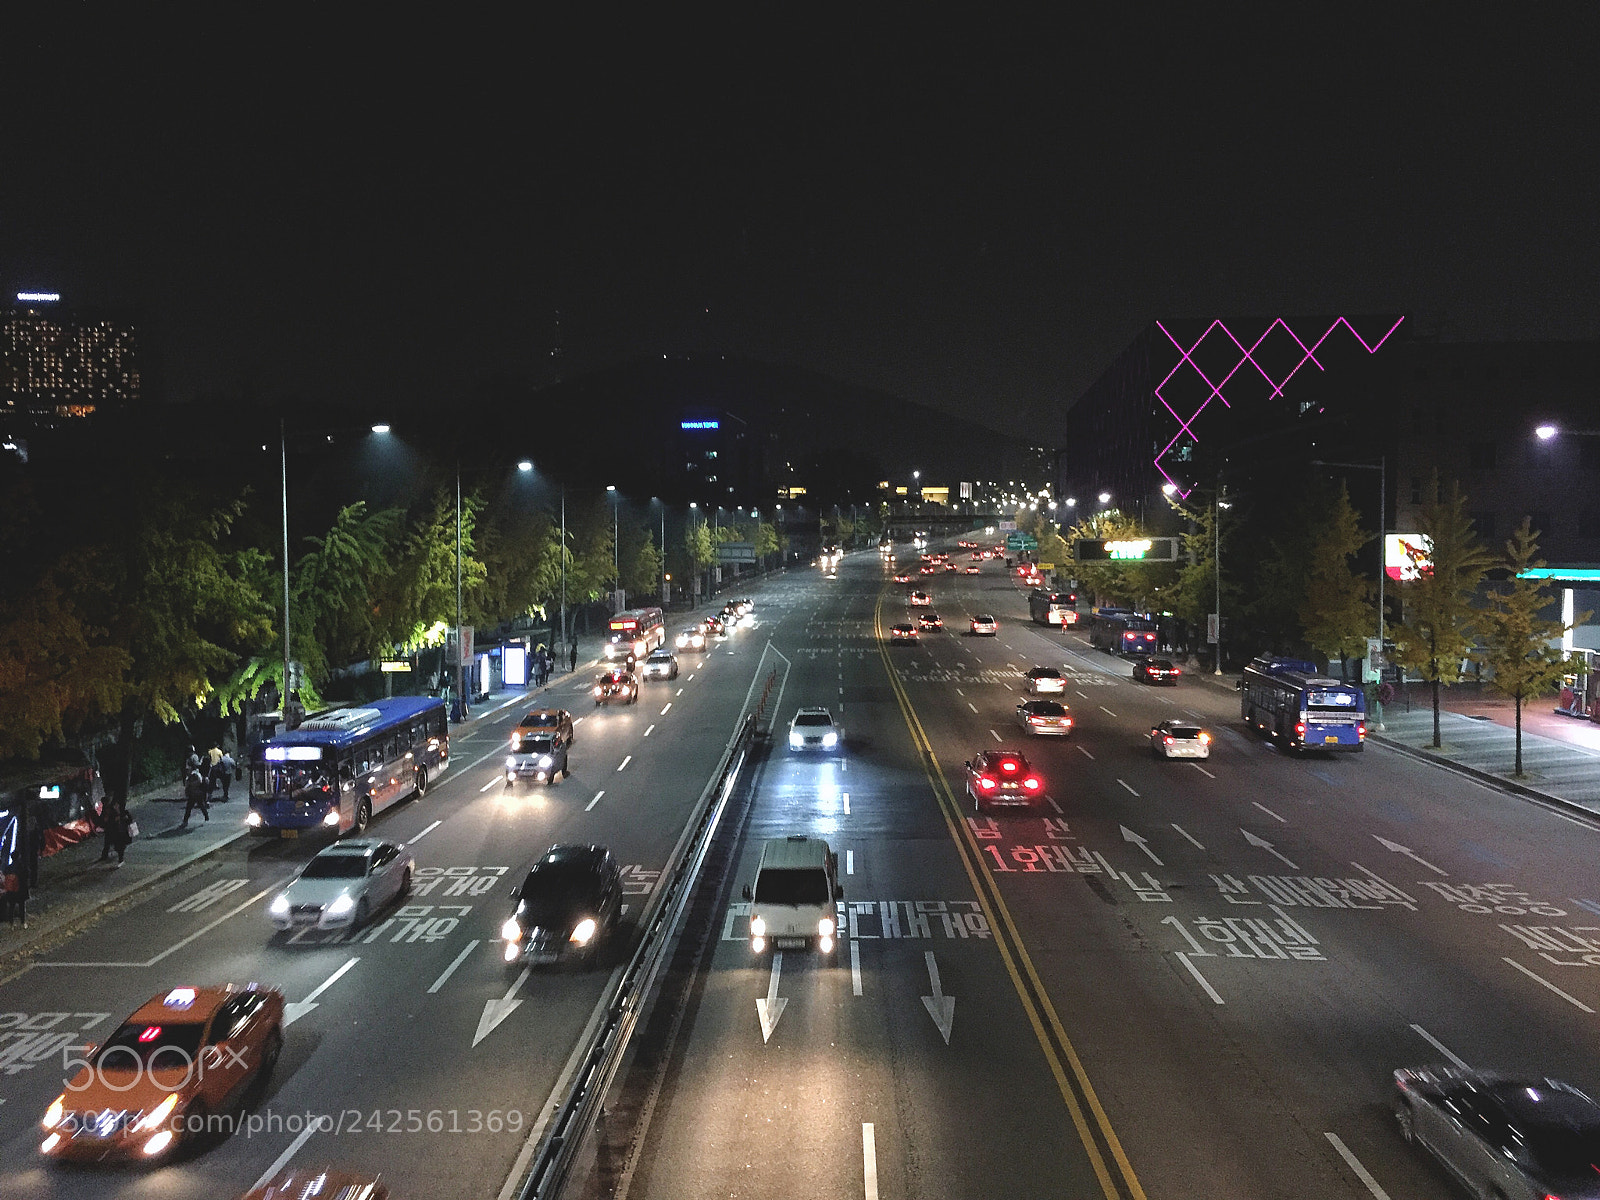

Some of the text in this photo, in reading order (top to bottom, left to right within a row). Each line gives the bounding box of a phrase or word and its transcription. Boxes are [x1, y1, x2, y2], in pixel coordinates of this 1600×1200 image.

[984, 845, 1103, 873] 1호터널
[848, 901, 991, 939] 한남대교
[1161, 916, 1327, 960] 1호터널
